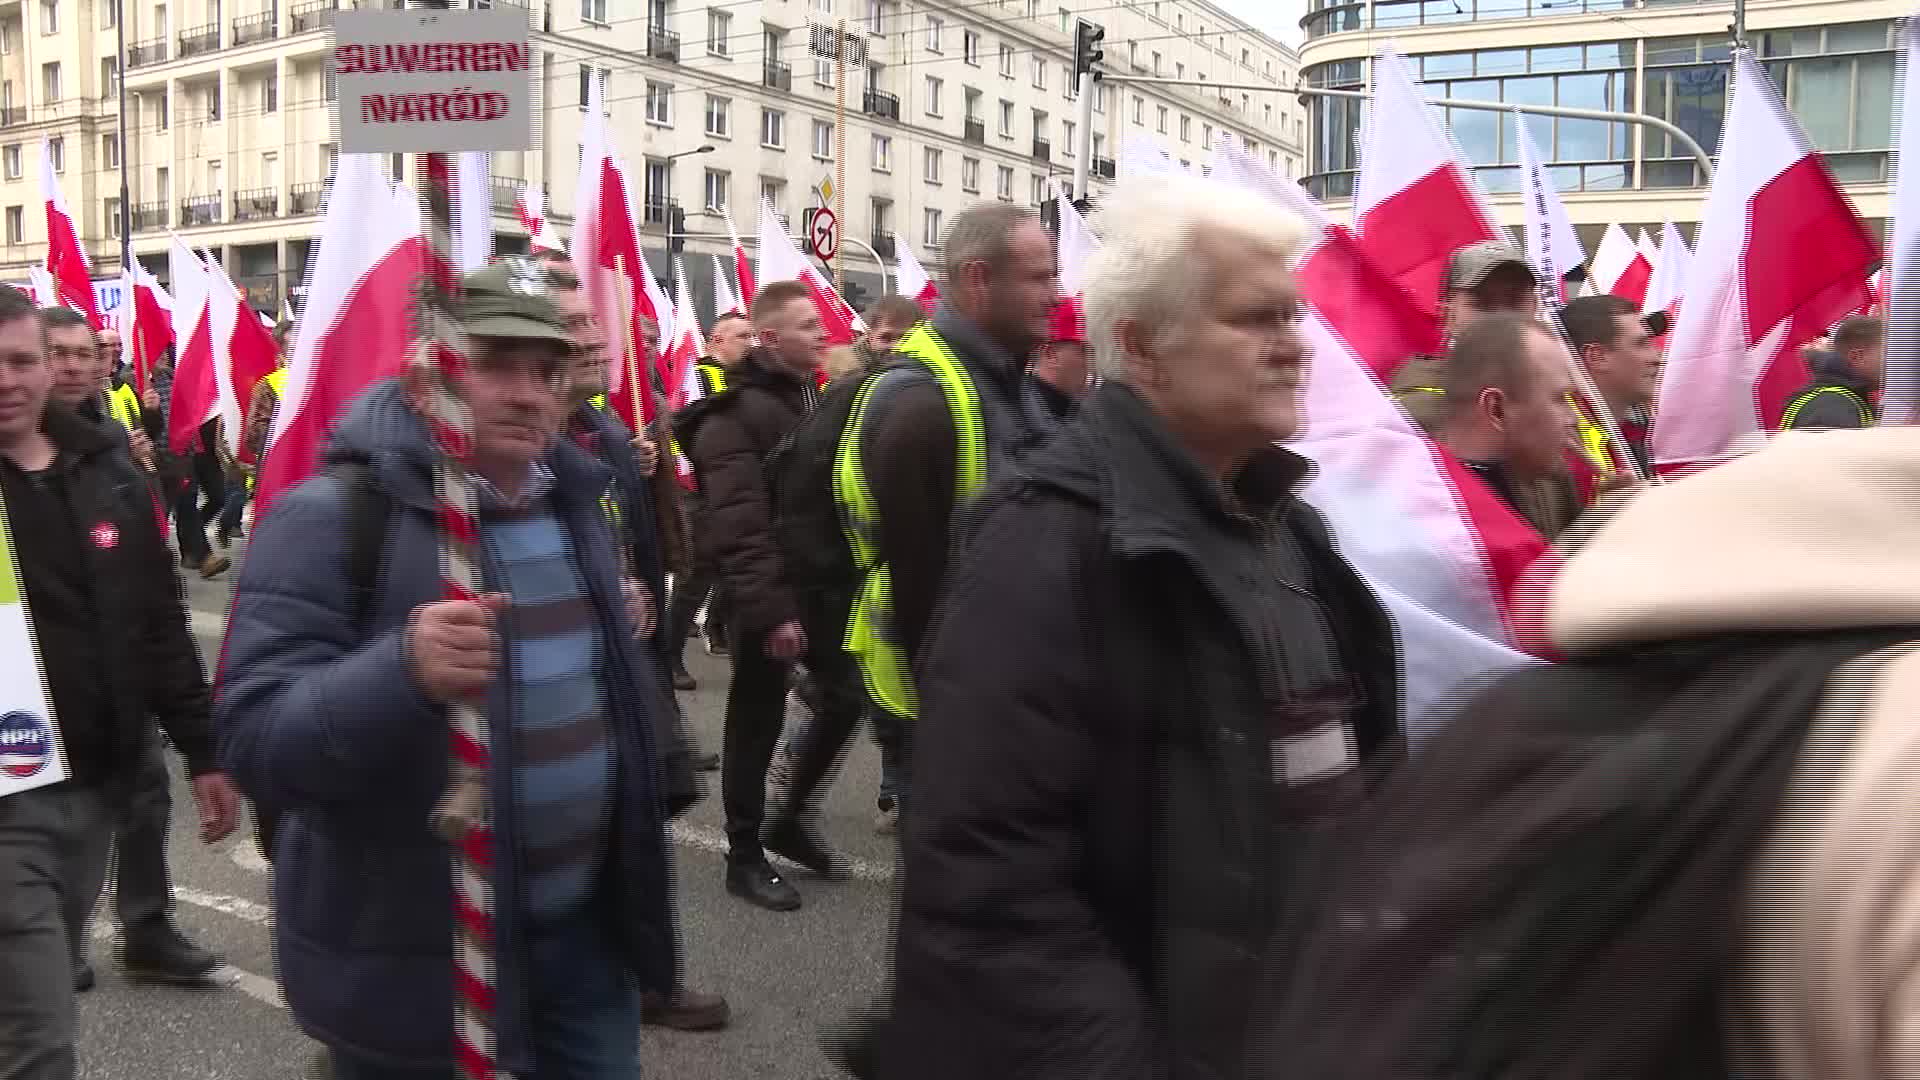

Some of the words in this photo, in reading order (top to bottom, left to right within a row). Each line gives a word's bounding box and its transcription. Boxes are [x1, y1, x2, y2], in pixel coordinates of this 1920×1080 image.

[335, 41, 529, 74] SUWEREN
[808, 22, 870, 69] AUGUTÓW
[360, 87, 510, 123] NARÓD
